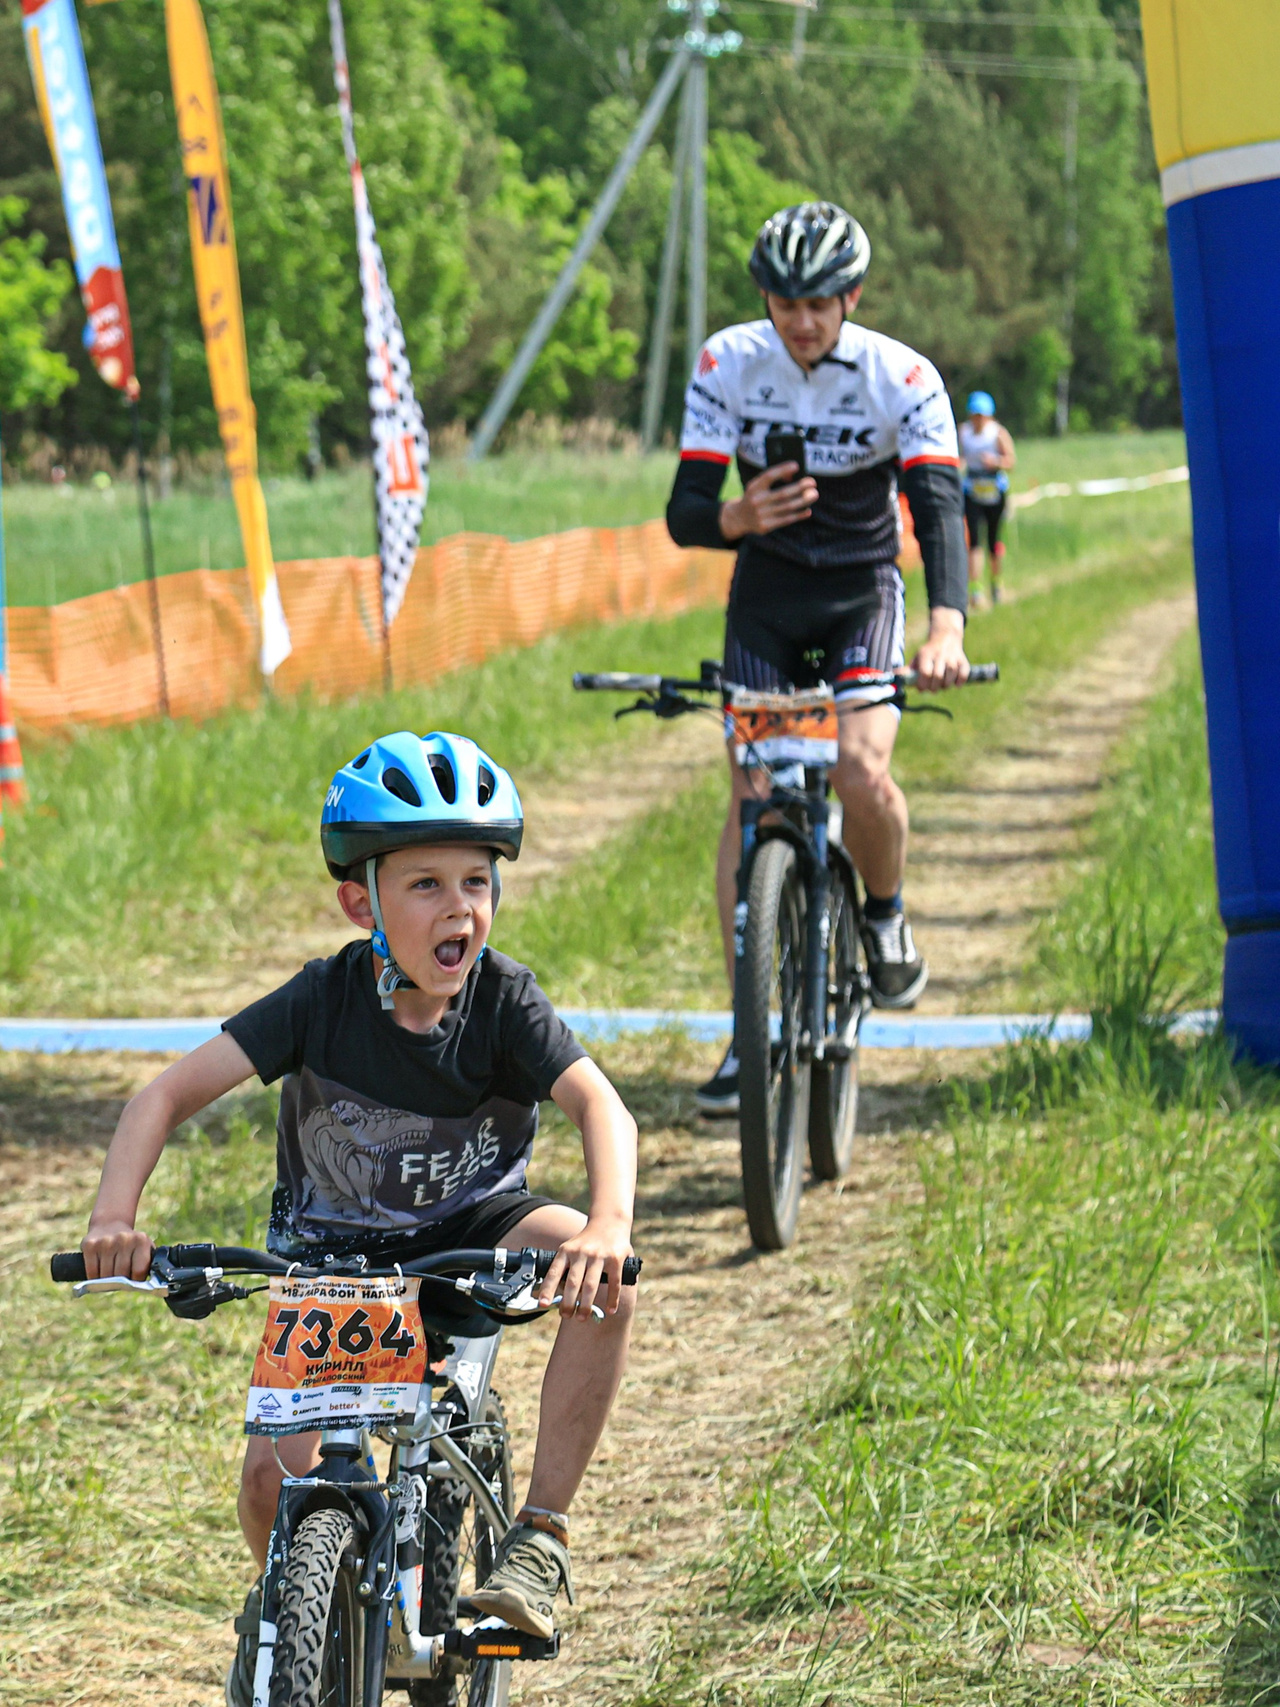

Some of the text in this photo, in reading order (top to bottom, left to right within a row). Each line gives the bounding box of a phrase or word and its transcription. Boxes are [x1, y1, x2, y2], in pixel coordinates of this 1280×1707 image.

[272, 1308, 417, 1360] 7364
[305, 1360, 365, 1376] КИРИЛЛ
[329, 1401, 361, 1411] better's
